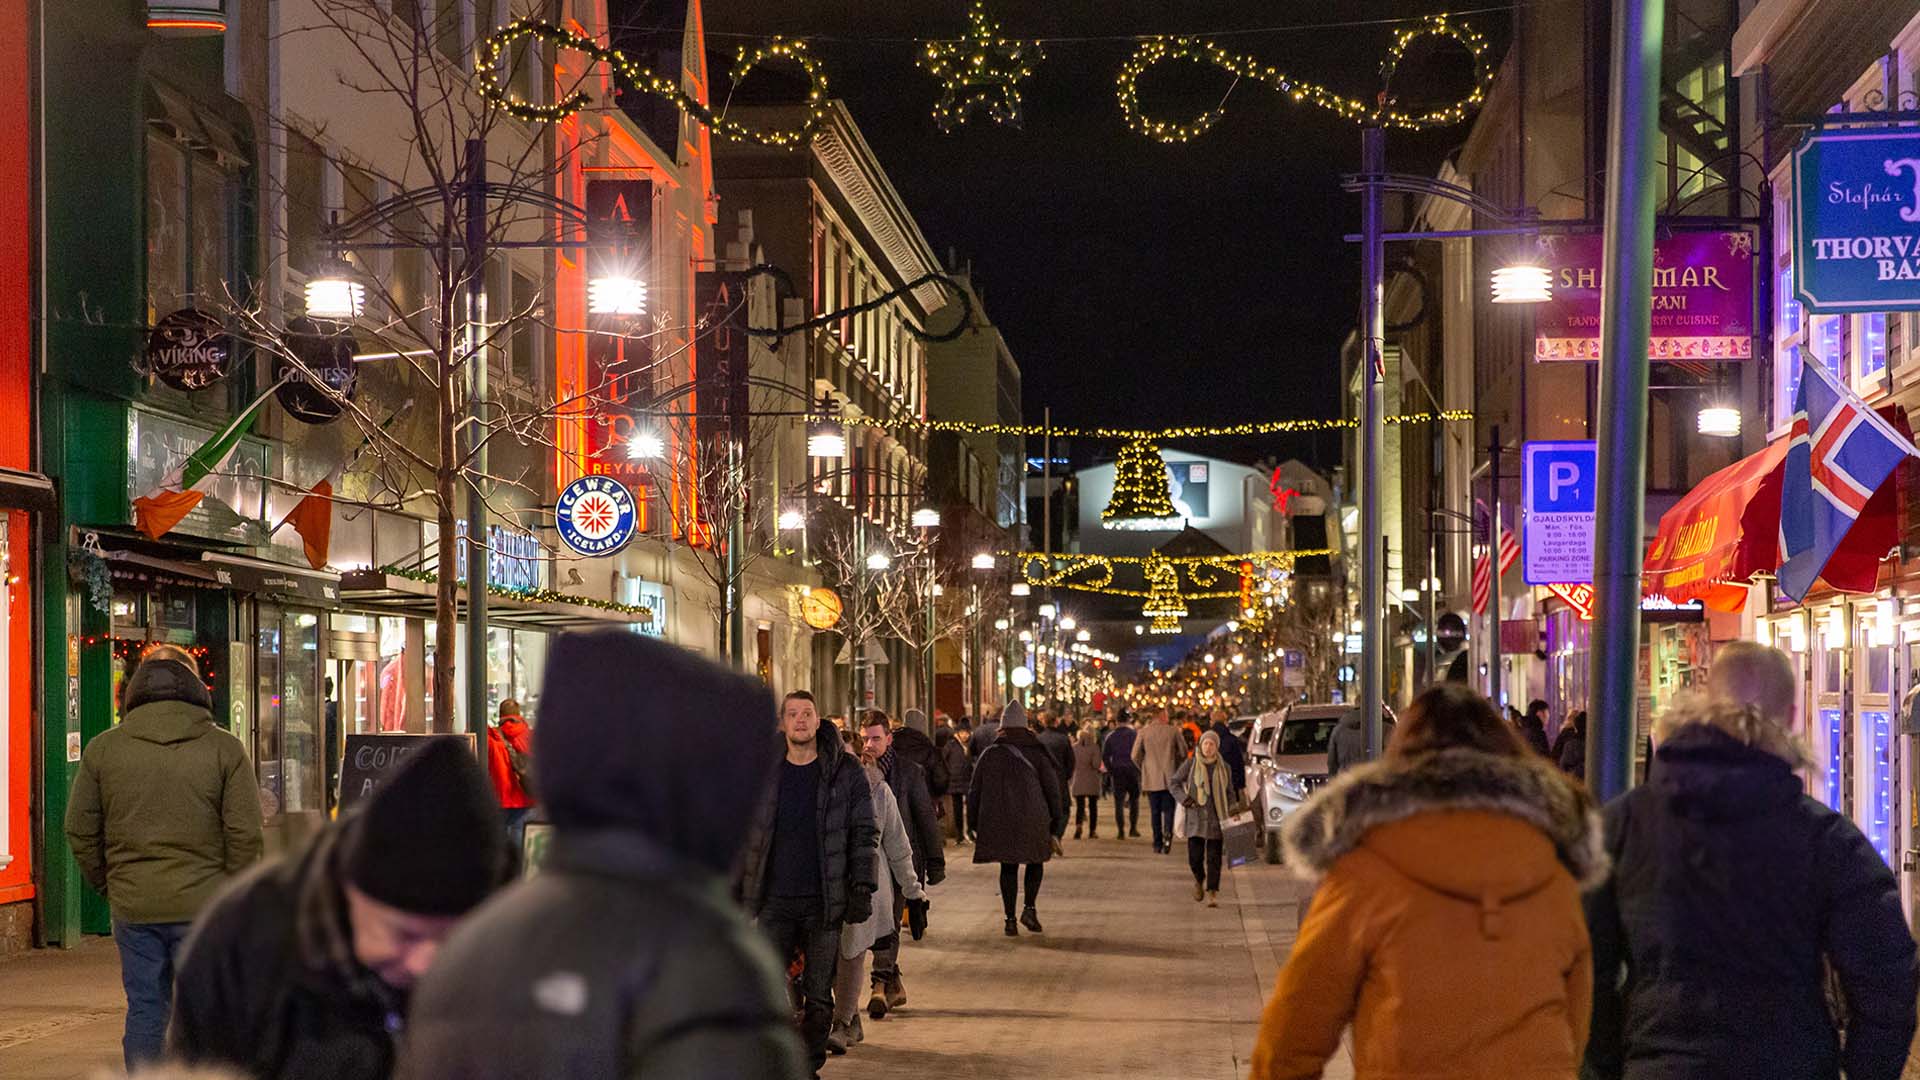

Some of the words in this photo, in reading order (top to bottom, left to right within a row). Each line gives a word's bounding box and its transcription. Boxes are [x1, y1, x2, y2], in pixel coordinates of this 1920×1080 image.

[1878, 259, 1920, 281] BA
[1677, 315, 1719, 325] CUISINE
[1549, 461, 1580, 502] P
[559, 479, 631, 515] ICEWEAR
[1573, 488, 1580, 499] 1
[567, 531, 622, 550] ICELAND
